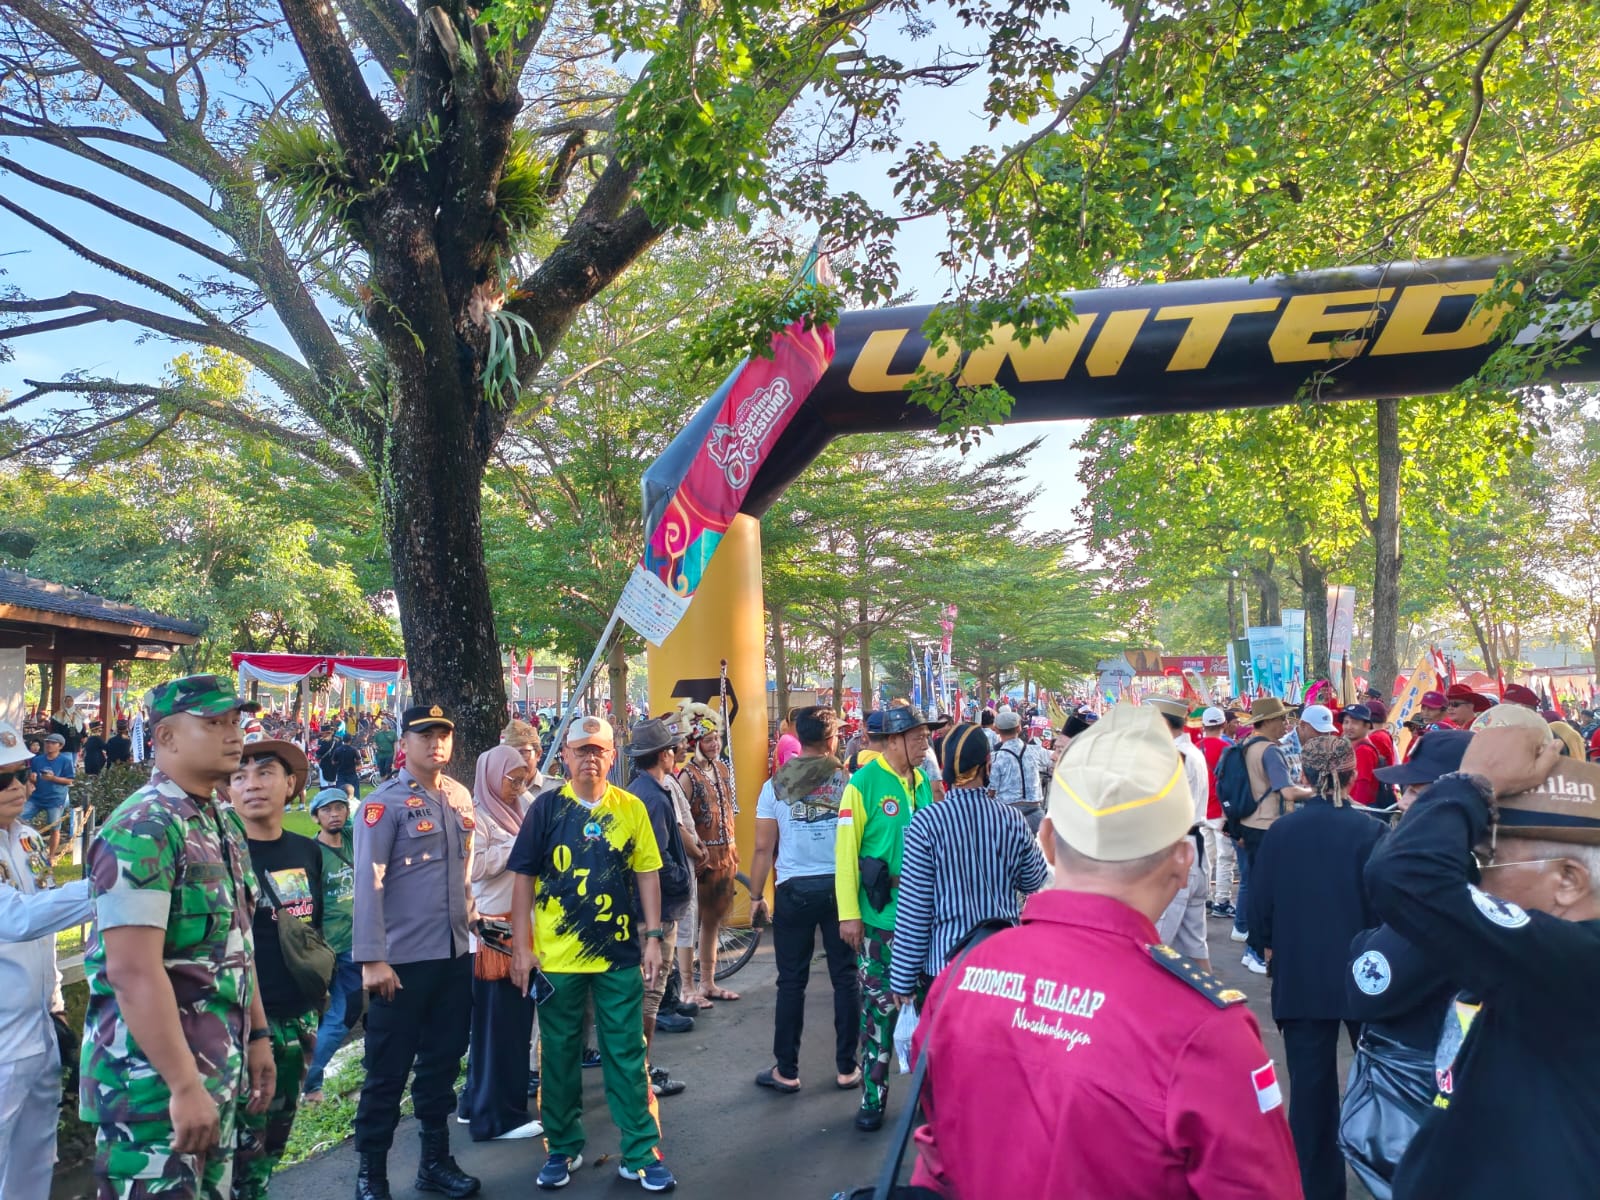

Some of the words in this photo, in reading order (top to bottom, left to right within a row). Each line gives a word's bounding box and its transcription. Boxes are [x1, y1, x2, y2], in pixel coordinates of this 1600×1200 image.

[848, 278, 1525, 393] UNITED
[738, 391, 772, 437] Cycling
[741, 381, 788, 447] Festival
[1523, 774, 1597, 801] ilan
[407, 808, 433, 820] ARIE
[1033, 978, 1106, 1019] CILACAP
